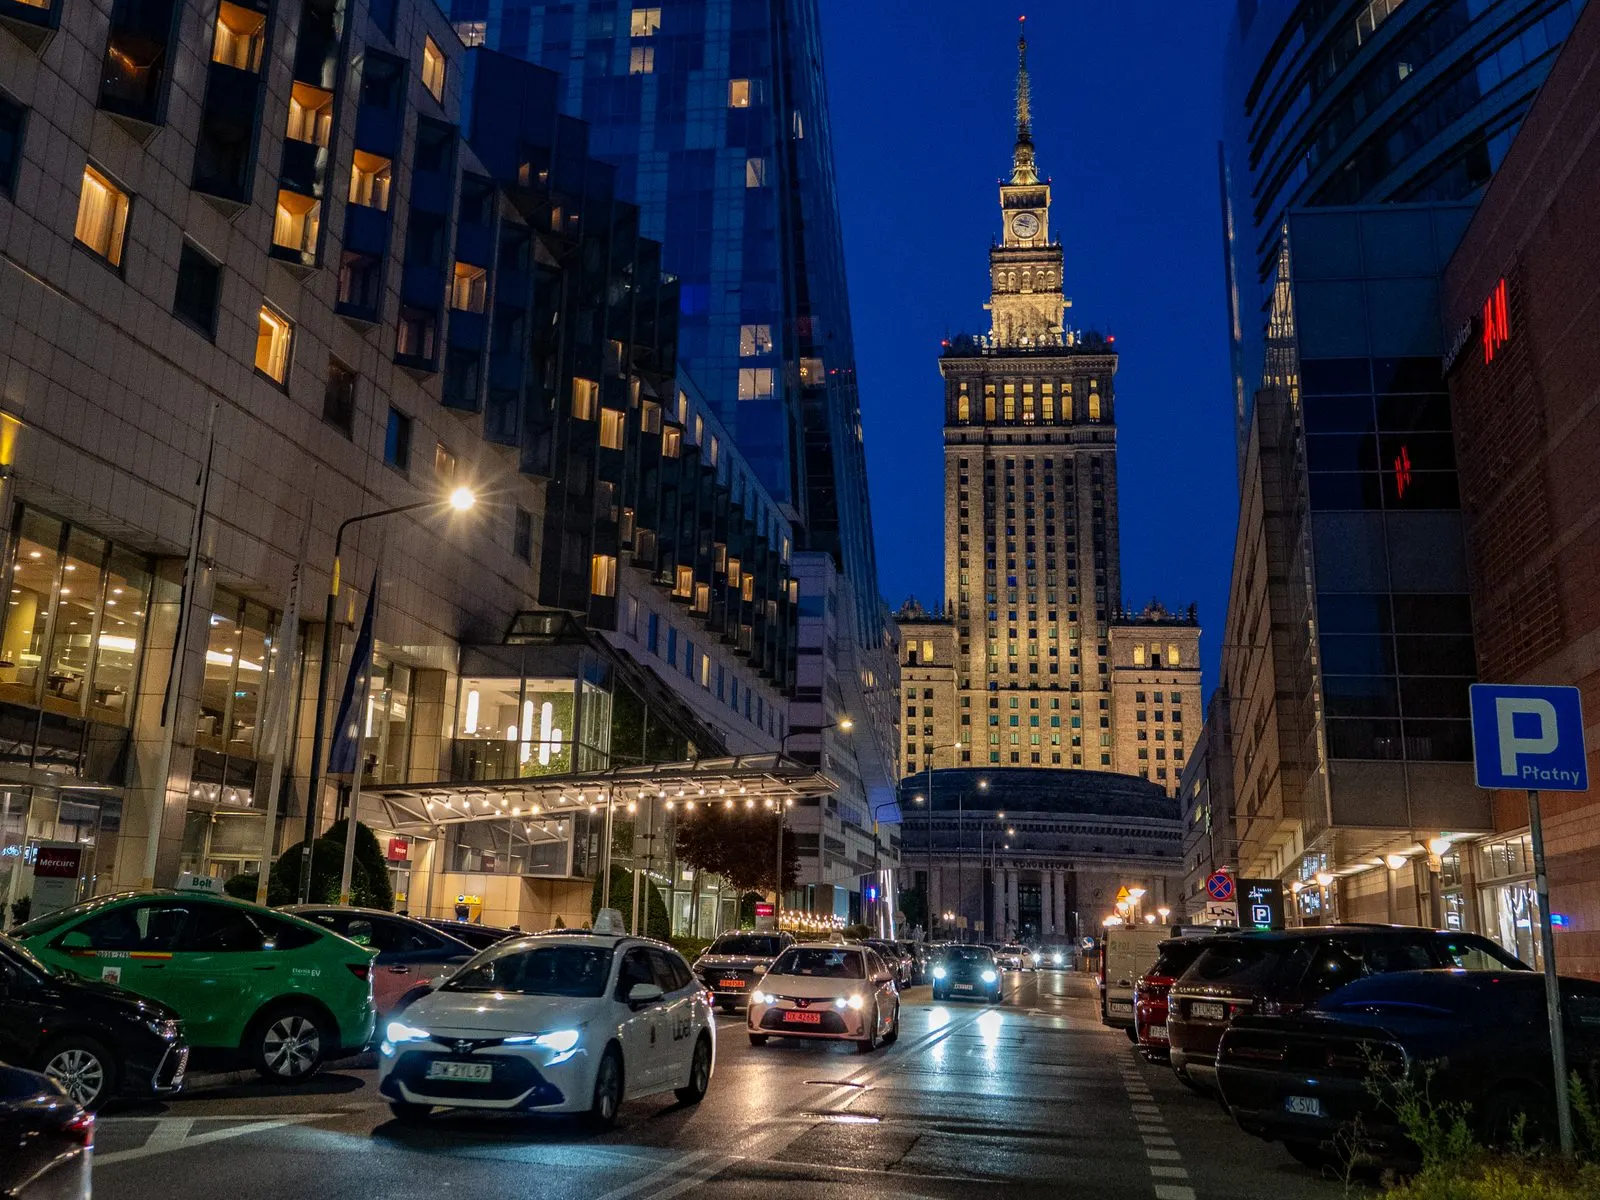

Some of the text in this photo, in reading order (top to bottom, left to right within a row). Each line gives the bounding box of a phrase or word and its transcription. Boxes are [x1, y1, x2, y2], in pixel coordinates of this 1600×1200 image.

[1495, 697, 1559, 776] P
[1522, 765, 1580, 786] Płatny
[40, 858, 75, 867] Mercure
[192, 877, 212, 888] Bolt
[1256, 908, 1267, 921] P
